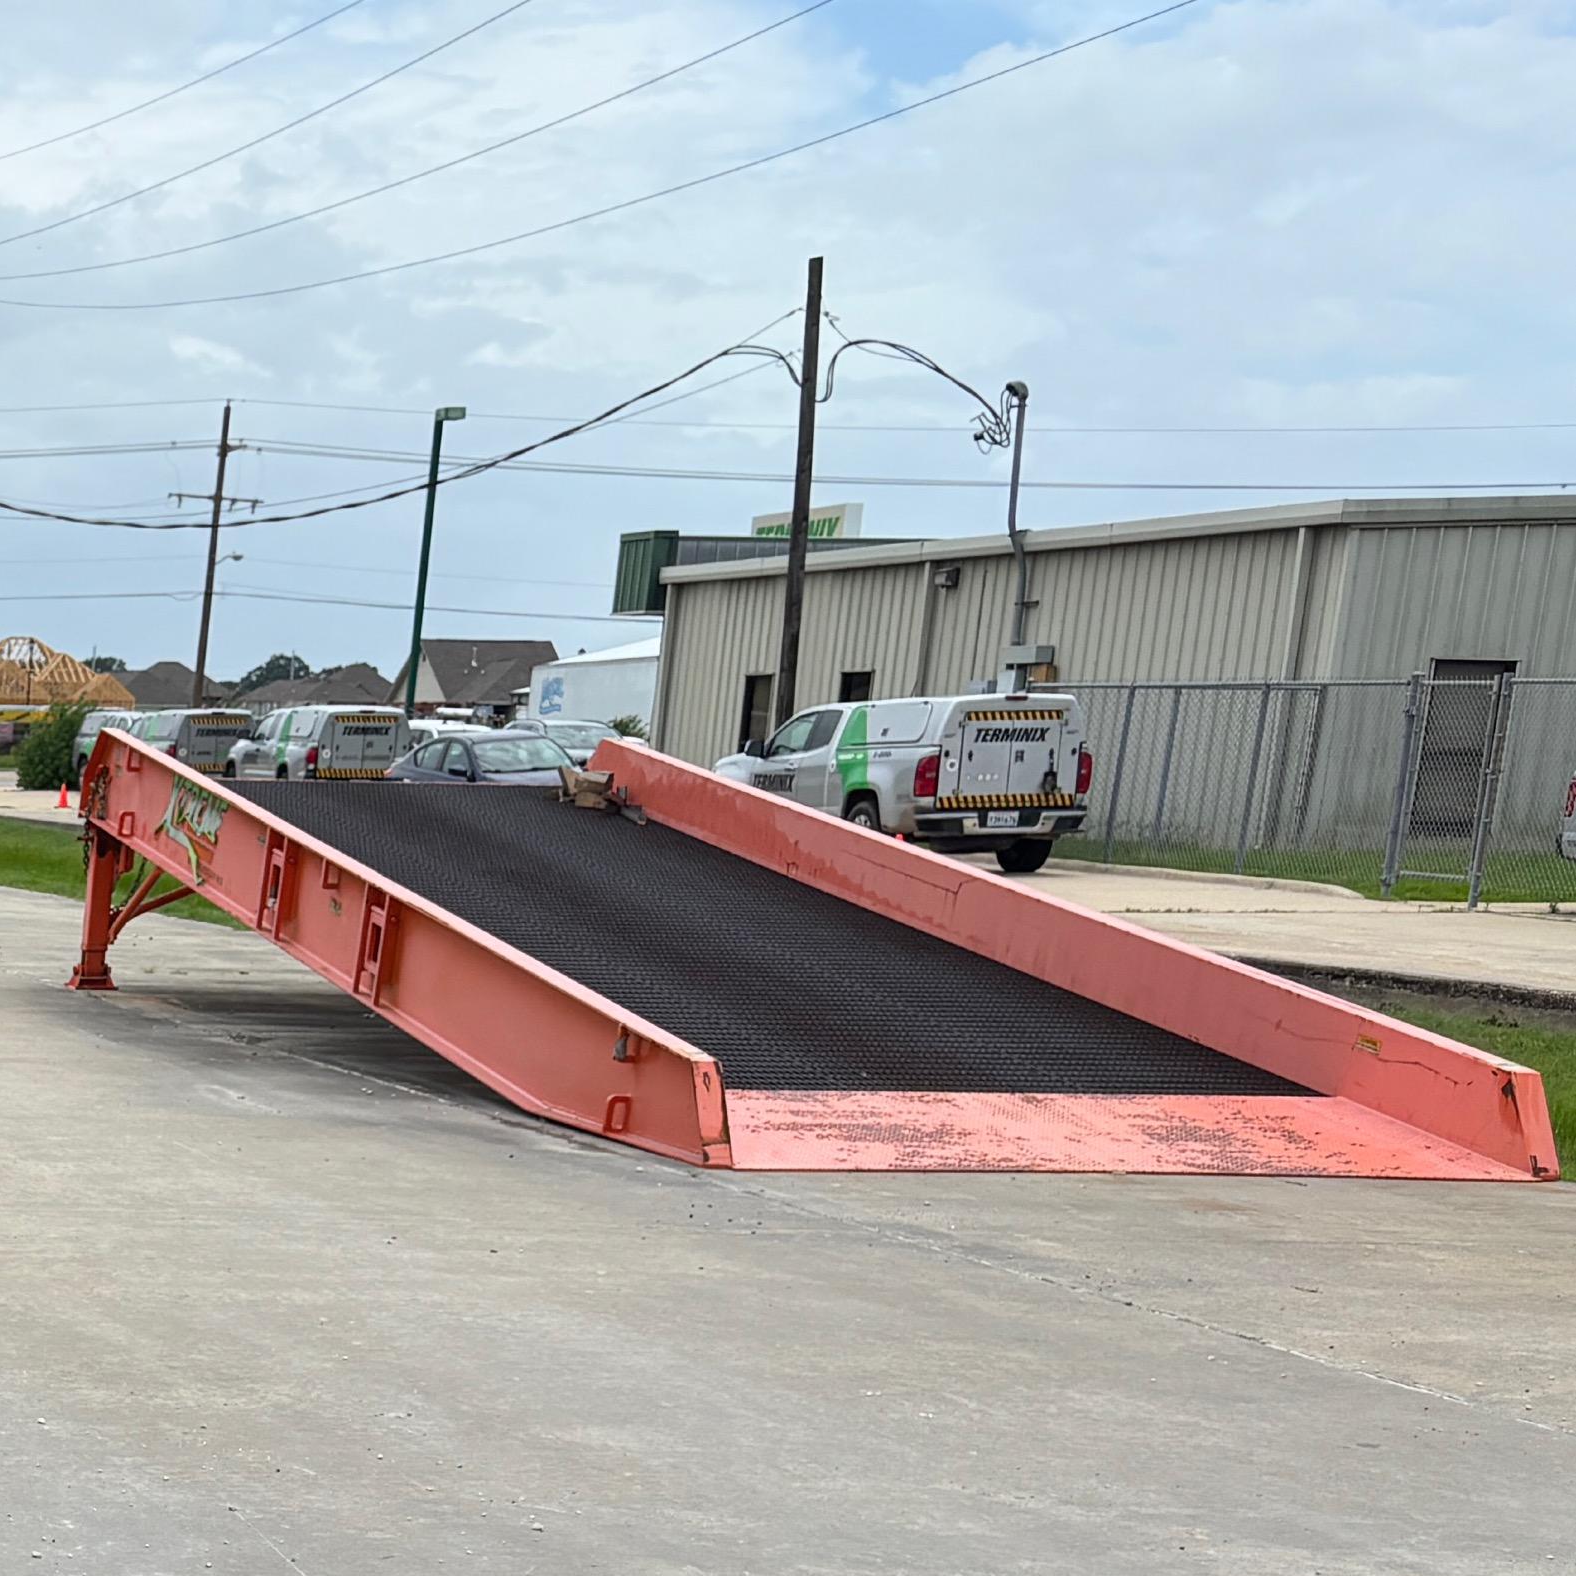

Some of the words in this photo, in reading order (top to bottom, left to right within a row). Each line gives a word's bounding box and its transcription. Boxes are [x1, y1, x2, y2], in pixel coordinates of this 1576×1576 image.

[342, 726, 390, 736] TERMINIX
[974, 728, 1050, 743] TERMINIX
[753, 773, 795, 792] TERMINIX
